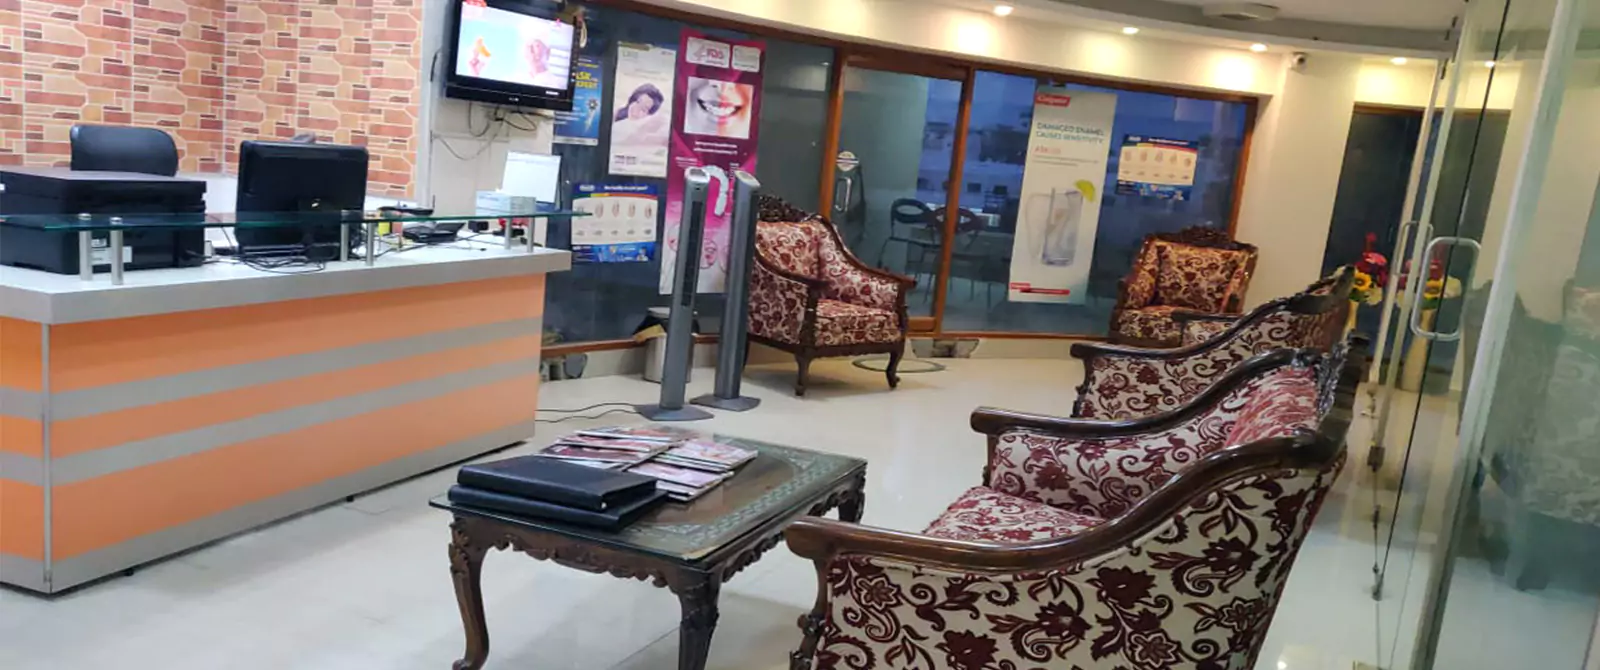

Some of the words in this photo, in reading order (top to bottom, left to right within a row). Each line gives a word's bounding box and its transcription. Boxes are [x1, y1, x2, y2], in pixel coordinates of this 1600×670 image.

[1036, 121, 1075, 133] DAMAGED
[1076, 126, 1105, 136] ENAMEL
[1035, 130, 1062, 140] CAUSES
